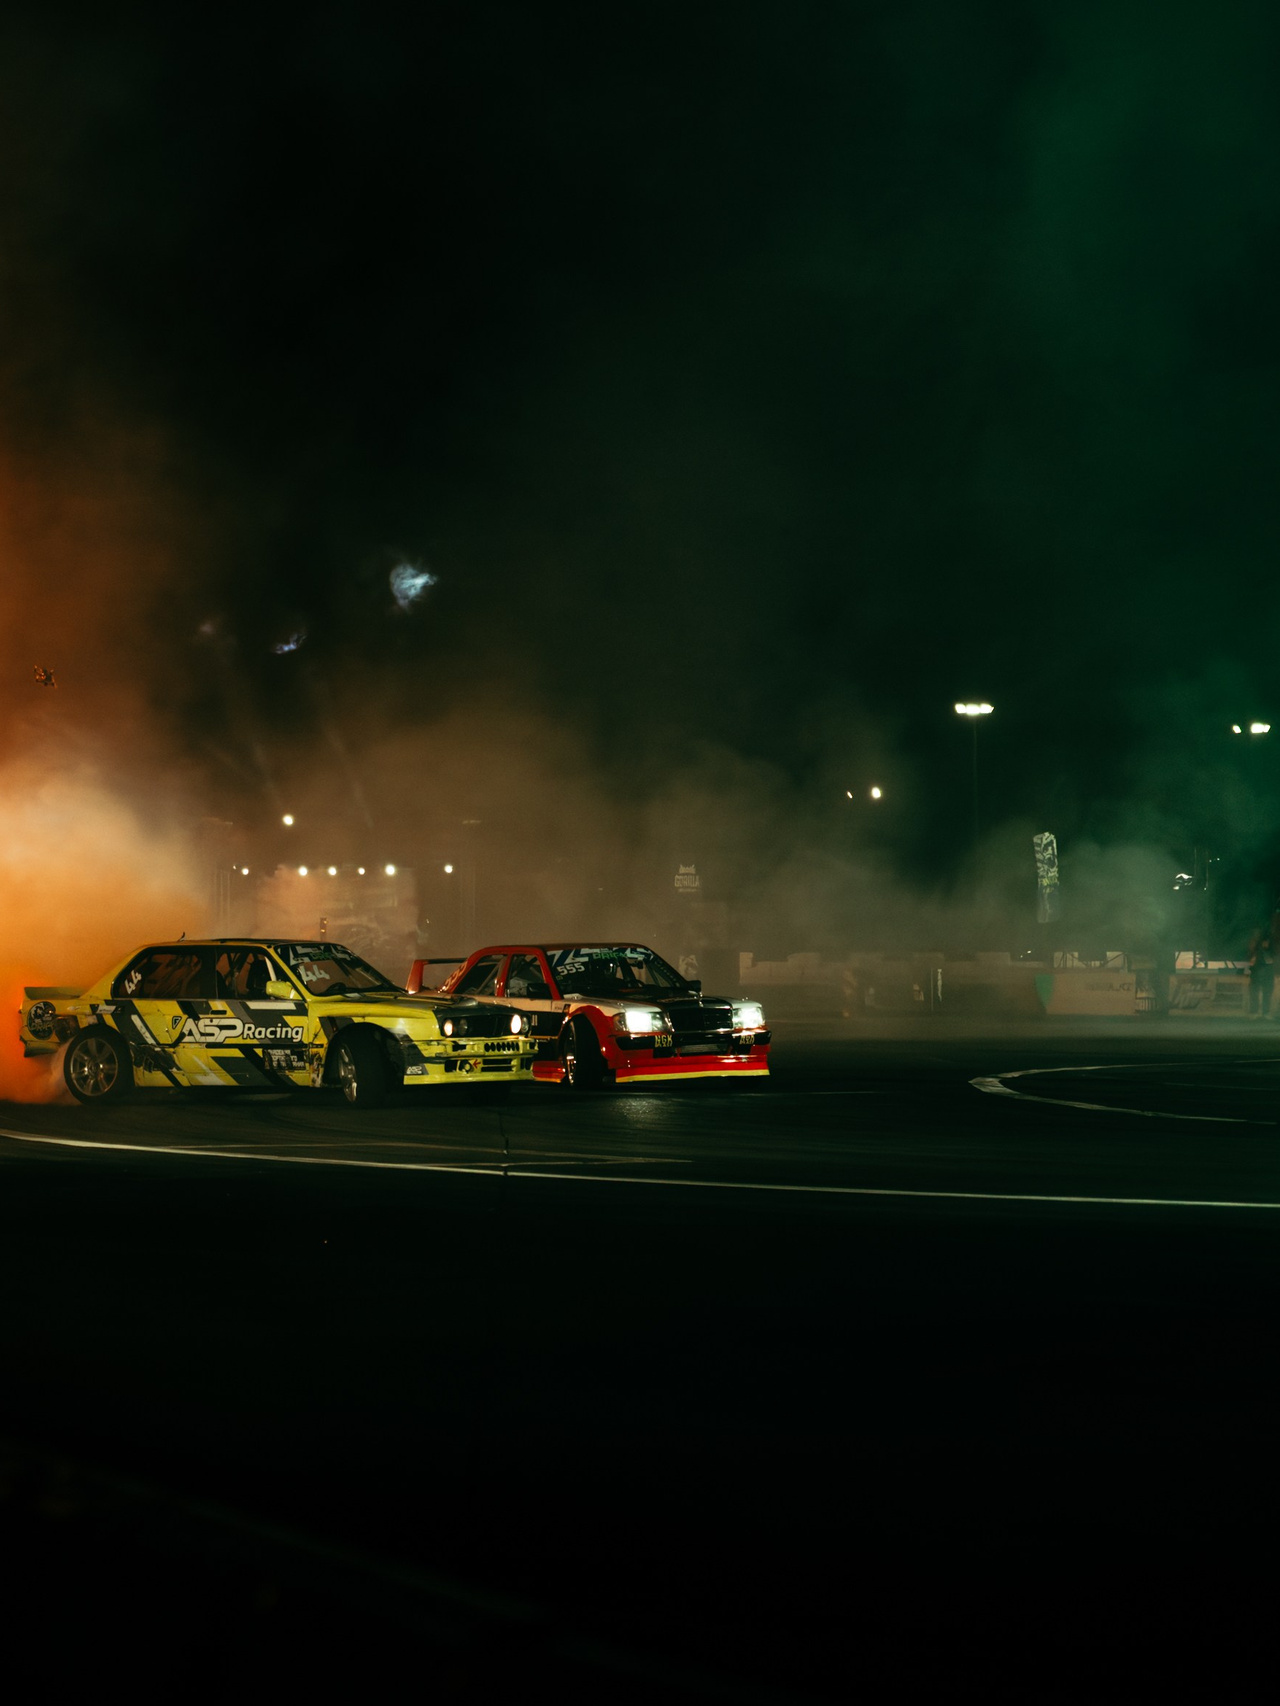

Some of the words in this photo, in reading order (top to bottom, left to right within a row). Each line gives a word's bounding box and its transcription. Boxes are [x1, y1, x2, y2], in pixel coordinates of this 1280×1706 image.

[299, 964, 330, 982] 44
[556, 962, 586, 976] 555
[124, 969, 142, 995] 44
[179, 1017, 244, 1043] ASP
[243, 1023, 304, 1042] Racing
